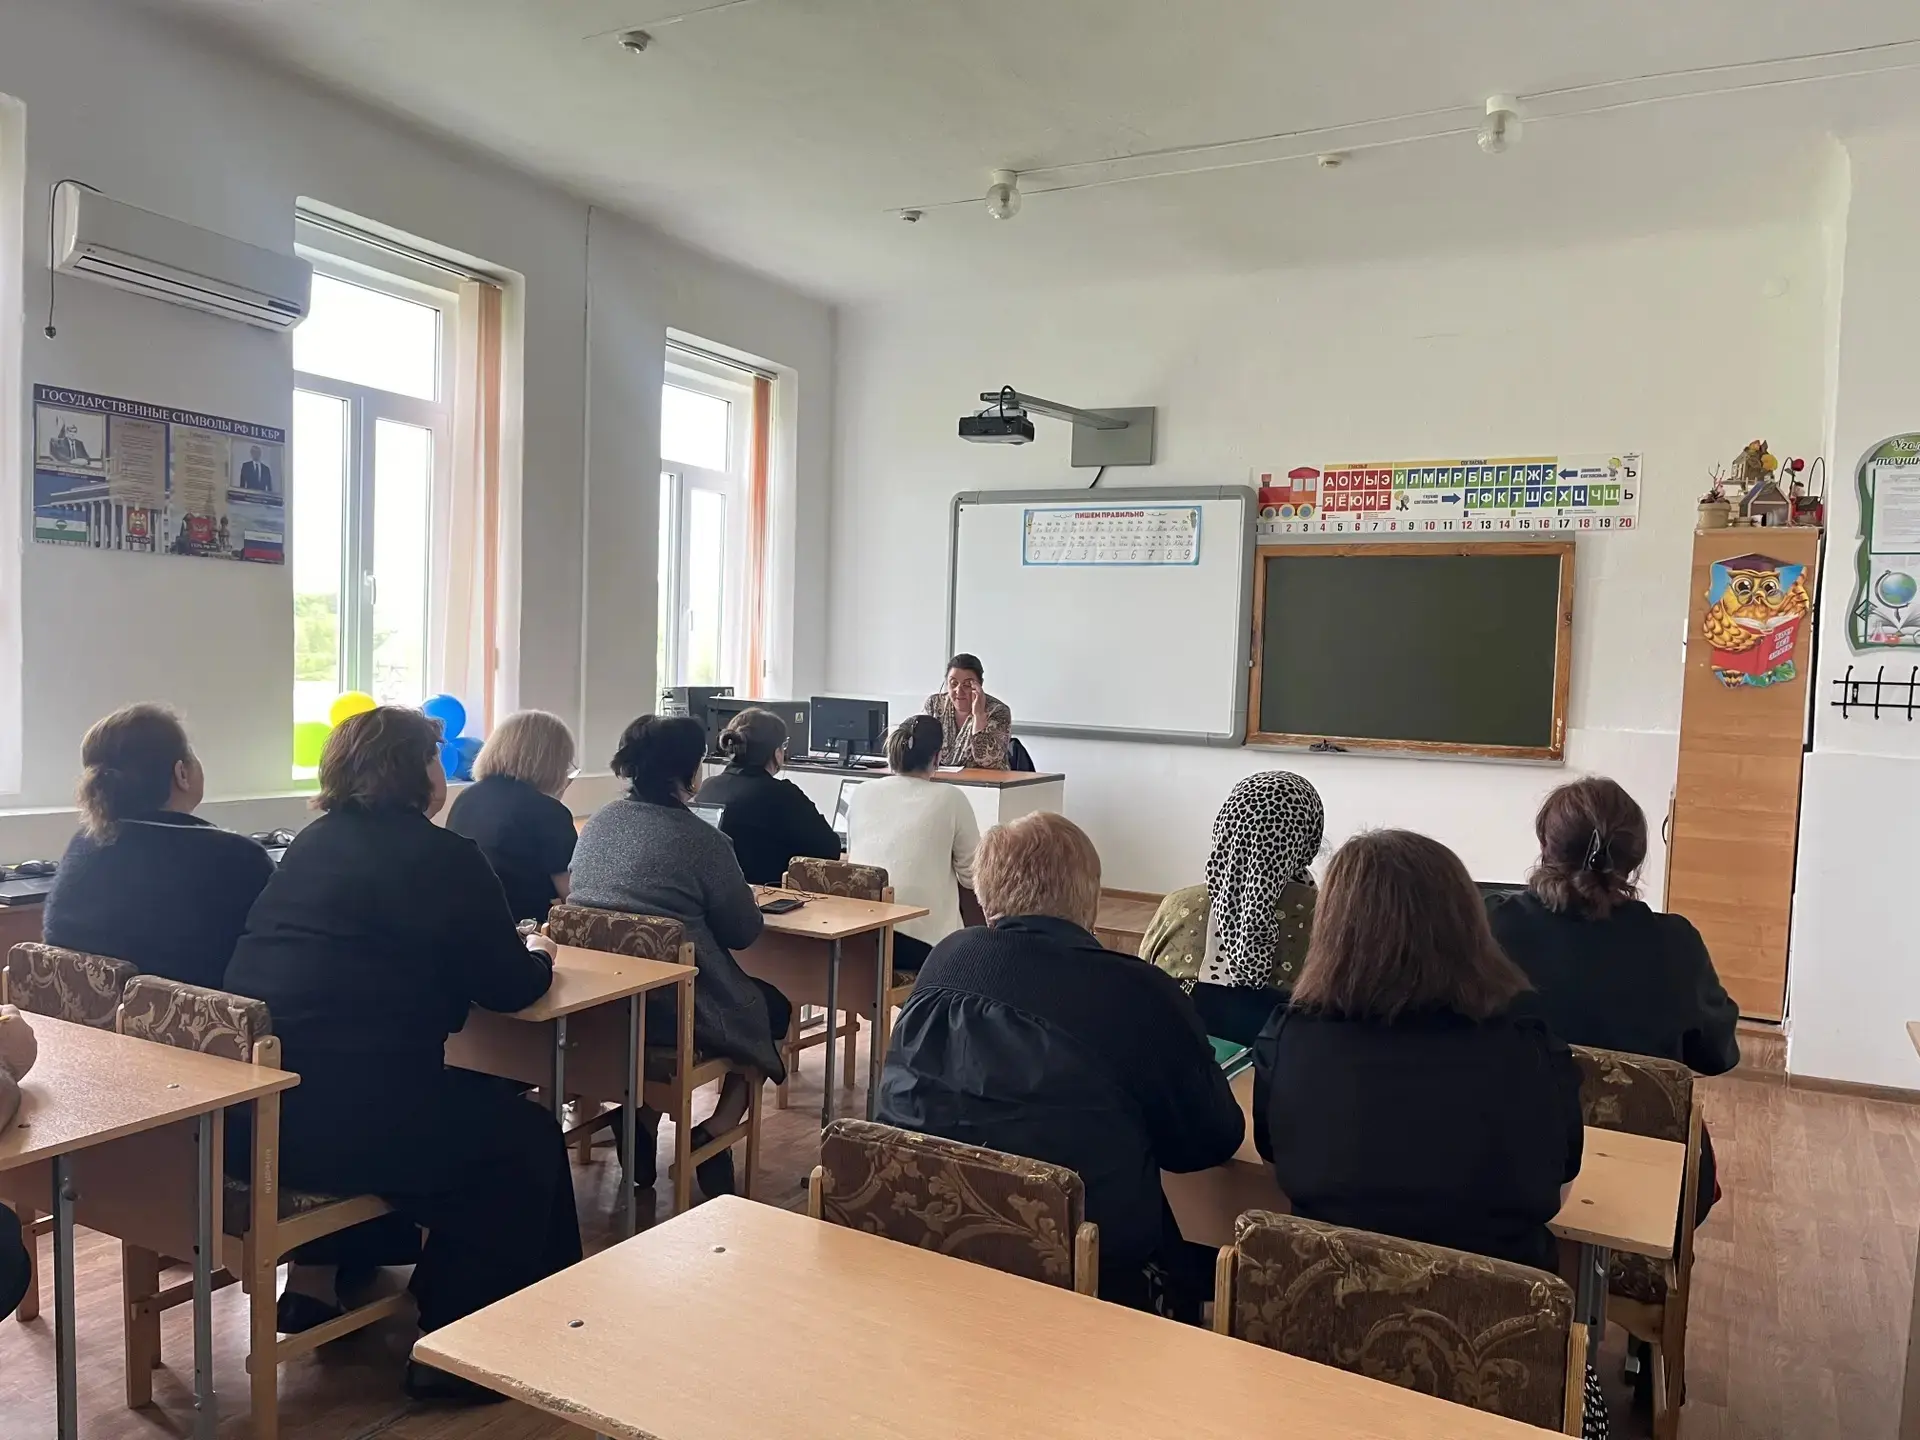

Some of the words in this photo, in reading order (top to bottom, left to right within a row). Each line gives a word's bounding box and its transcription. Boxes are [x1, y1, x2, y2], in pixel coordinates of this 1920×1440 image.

[42, 388, 170, 420] ГОСУДАРСТВЕННЫЕ
[172, 411, 231, 431] СИМВОЛЫ
[234, 423, 249, 434] РФ
[251, 426, 258, 436] И
[261, 429, 280, 440] КБР
[1891, 438, 1920, 451] Уго
[1876, 457, 1920, 466] техни
[1325, 476, 1335, 487] А
[1339, 475, 1349, 487] О
[1353, 475, 1362, 486] У
[1365, 475, 1378, 486] Ы
[1381, 474, 1390, 485] Э
[1395, 471, 1404, 485] Й
[1409, 473, 1419, 484] Л
[1423, 472, 1434, 484] М
[1438, 472, 1448, 484] Н
[1453, 472, 1462, 483] Р
[1468, 471, 1478, 483] Б
[1483, 471, 1493, 482] В
[1499, 471, 1507, 482] Г
[1512, 470, 1524, 484] Д
[1527, 469, 1541, 481] Ж
[1544, 469, 1554, 480] З
[1623, 466, 1637, 478] Ъ
[1324, 496, 1334, 507] Я
[1338, 493, 1347, 507] Ё
[1350, 495, 1363, 506] Ю
[1365, 495, 1375, 506] И
[1380, 495, 1389, 506] Е
[1467, 492, 1476, 504] П
[1480, 491, 1493, 503] Ф
[1497, 491, 1506, 503] К
[1512, 491, 1522, 503] Т
[1526, 491, 1540, 502] Ш
[1543, 490, 1553, 502] С
[1558, 490, 1569, 502] Х
[1574, 489, 1585, 503] Ц
[1591, 489, 1601, 501] Ч
[1605, 489, 1620, 503] Щ
[1623, 489, 1634, 500] Ь
[1074, 511, 1101, 519] ПИШЕМ
[1270, 524, 1274, 533] 1
[1286, 523, 1292, 533] 2
[1302, 523, 1309, 532] 3
[1319, 523, 1326, 532] 4
[1337, 522, 1343, 532] 5
[1354, 522, 1361, 531] 6
[1372, 522, 1379, 531] 7
[1390, 521, 1396, 531] 8
[1408, 521, 1415, 530] 9
[1424, 521, 1436, 530] 10
[1443, 520, 1453, 530] 11
[1461, 520, 1473, 530] 12
[1480, 520, 1491, 529] 13
[1499, 520, 1510, 529] 14
[1518, 519, 1530, 529] 15
[1538, 519, 1550, 528] 16
[1558, 518, 1570, 528] 17
[1578, 518, 1590, 528] 18
[1598, 518, 1611, 528] 19
[1618, 517, 1632, 528] 20
[1034, 549, 1041, 560] 0
[1051, 550, 1056, 560] 1
[1065, 549, 1072, 560] 2
[1081, 549, 1088, 560] 3
[1098, 551, 1104, 560] 4
[1112, 549, 1119, 560] 5
[1131, 549, 1137, 560] 6
[1148, 549, 1155, 560] 7
[1166, 549, 1173, 560] 8
[1184, 549, 1191, 560] 9
